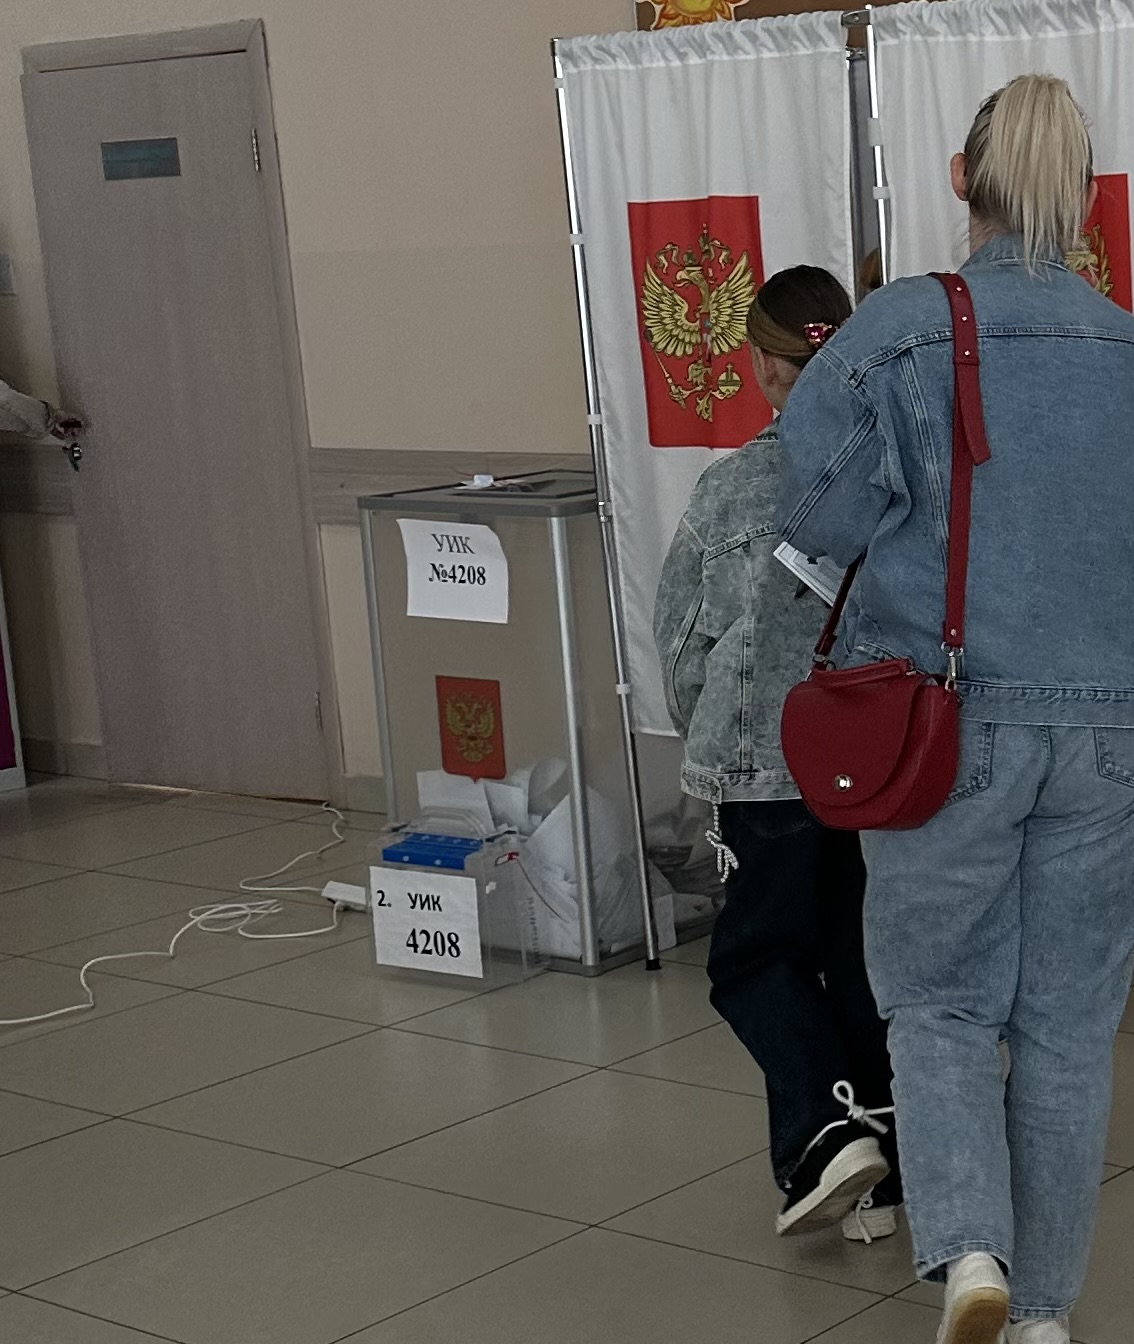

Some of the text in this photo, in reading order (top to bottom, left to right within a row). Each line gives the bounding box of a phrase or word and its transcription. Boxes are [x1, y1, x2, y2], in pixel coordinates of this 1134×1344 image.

[431, 533, 475, 554] УИК
[428, 562, 486, 586] №4208
[376, 889, 442, 912] 2. УИК
[405, 928, 461, 958] 4208
